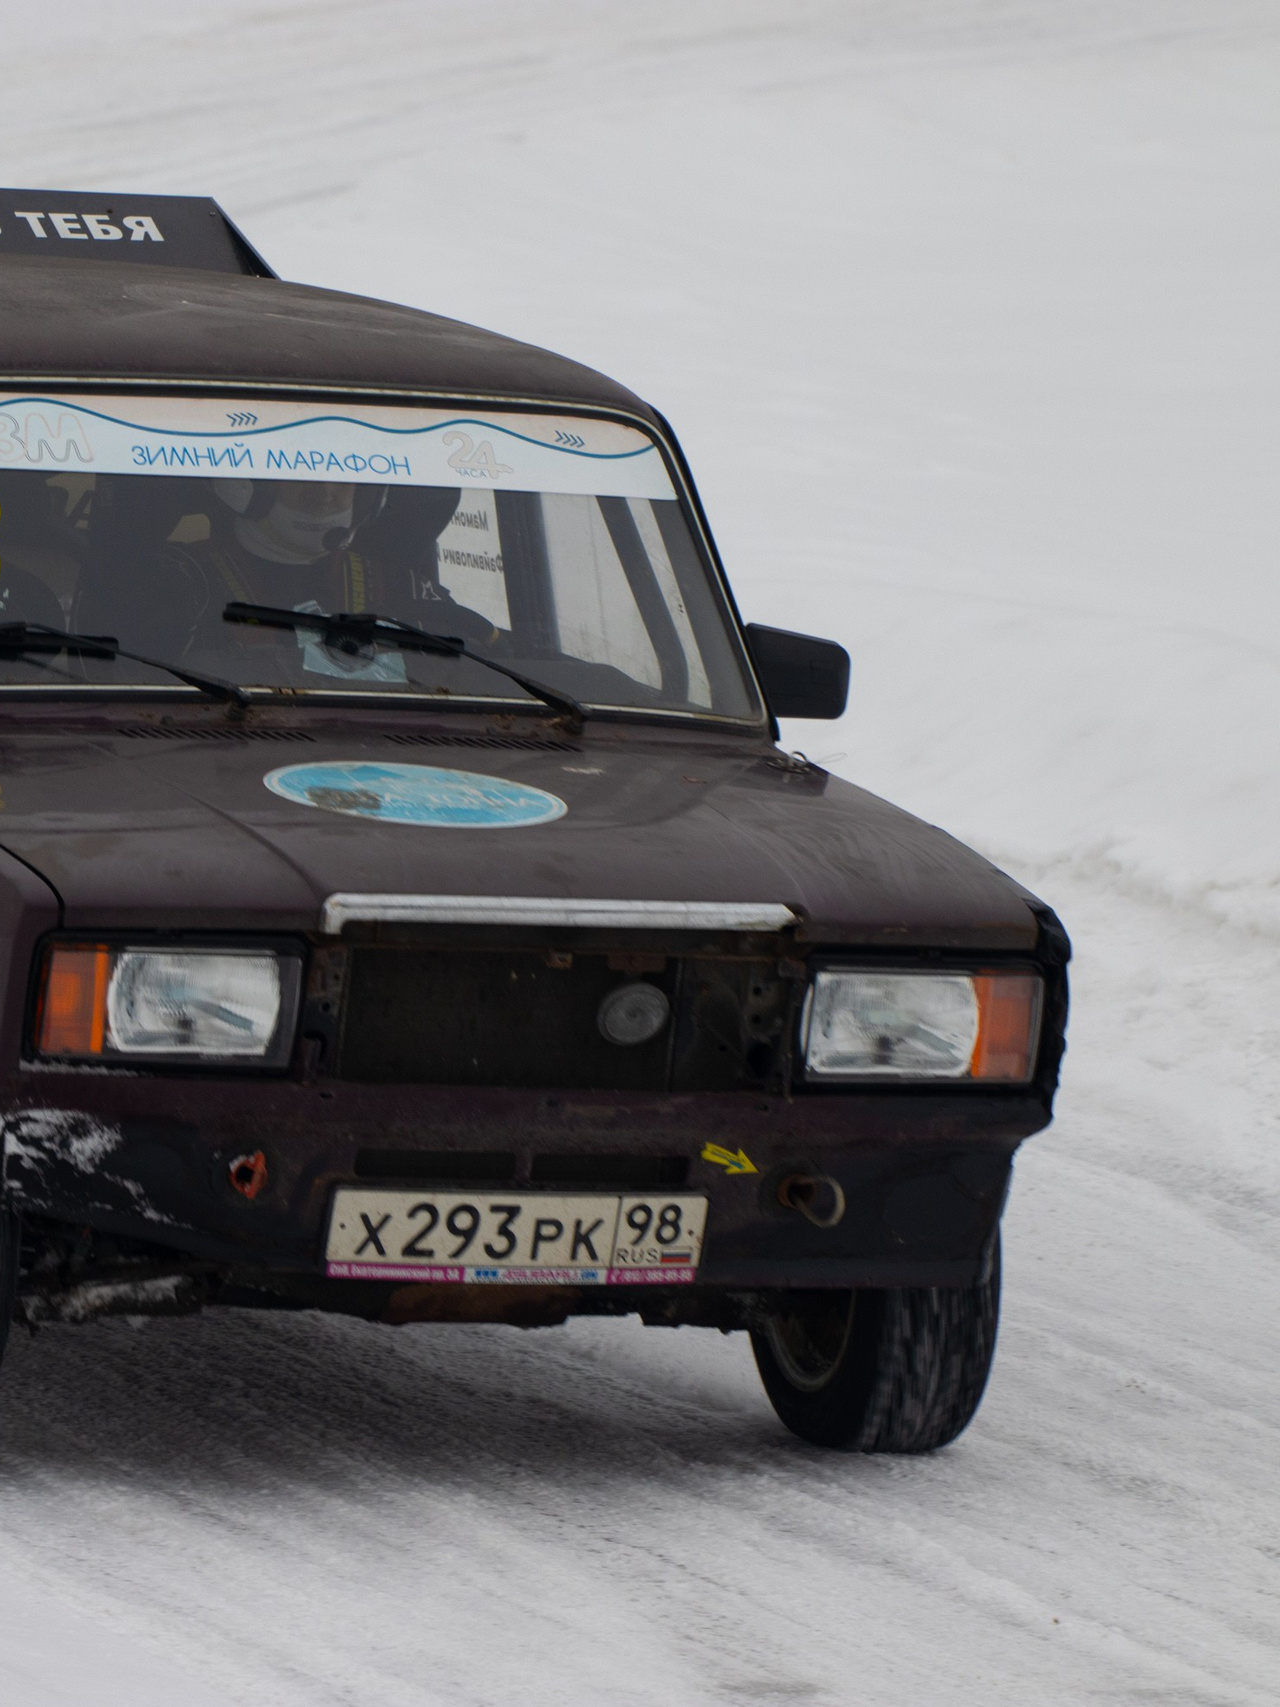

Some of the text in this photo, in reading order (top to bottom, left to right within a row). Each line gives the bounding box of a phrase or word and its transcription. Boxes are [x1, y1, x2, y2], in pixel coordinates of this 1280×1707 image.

[14, 211, 165, 243] ТЕБЯ
[131, 442, 411, 476] ЗИМНИЙ МАРАФОН
[626, 1203, 683, 1245] 98
[615, 1246, 659, 1265] RUS
